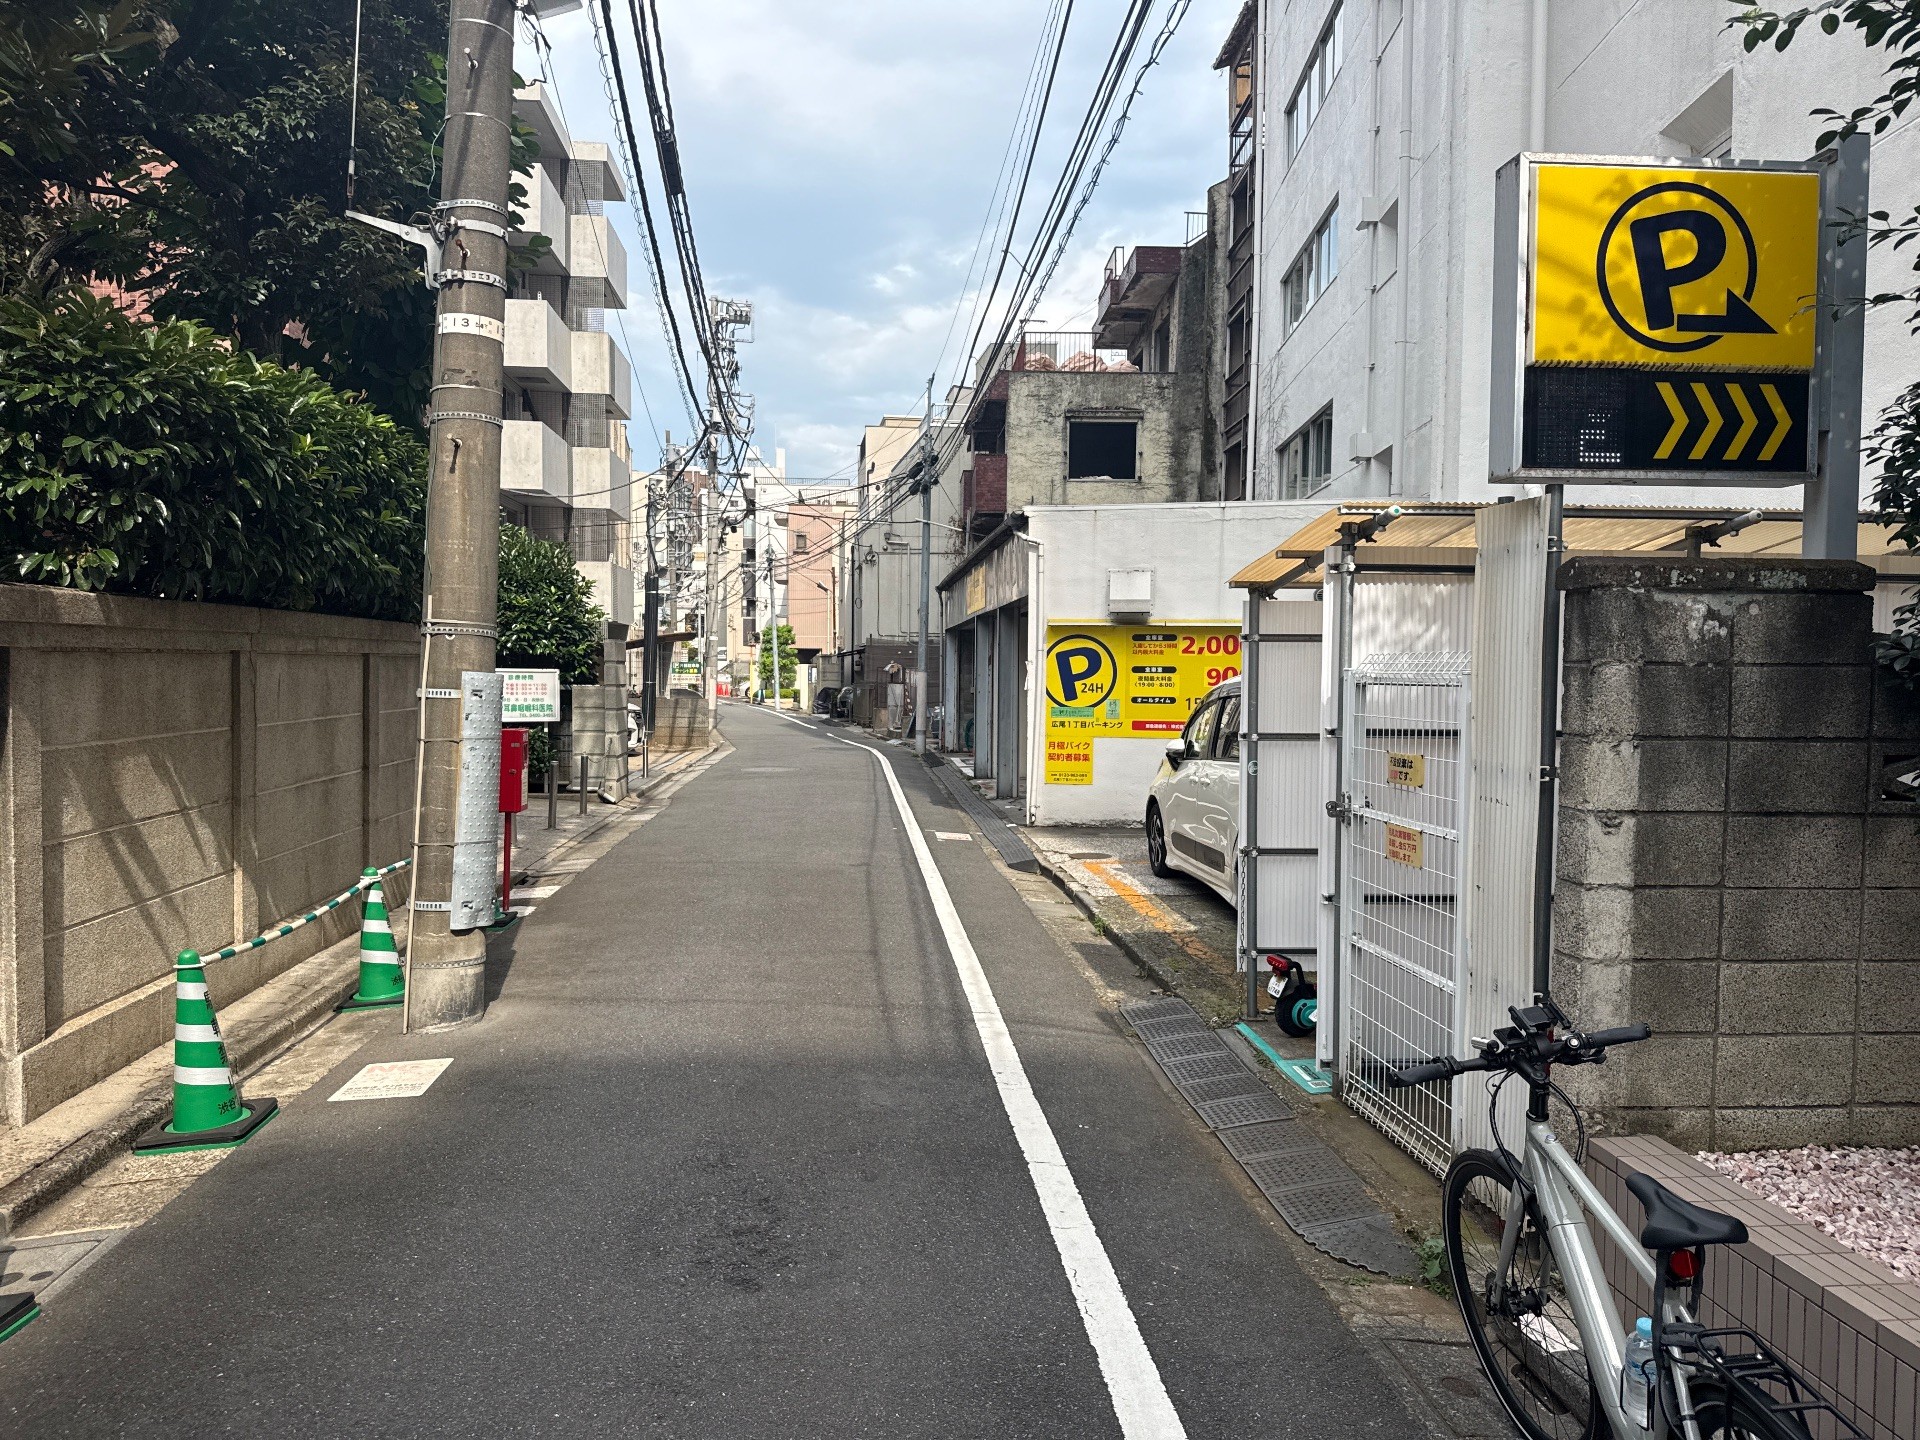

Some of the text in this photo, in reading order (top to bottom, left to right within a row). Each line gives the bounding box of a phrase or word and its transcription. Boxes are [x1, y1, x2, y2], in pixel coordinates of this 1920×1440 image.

[1630, 209, 1726, 331] P
[453, 317, 470, 328] 13
[1181, 634, 1242, 656] 2,00
[1055, 646, 1103, 702] P
[1081, 682, 1104, 694] 24H
[1048, 741, 1091, 750] 月極バイク
[1047, 753, 1091, 762] 契約者募集
